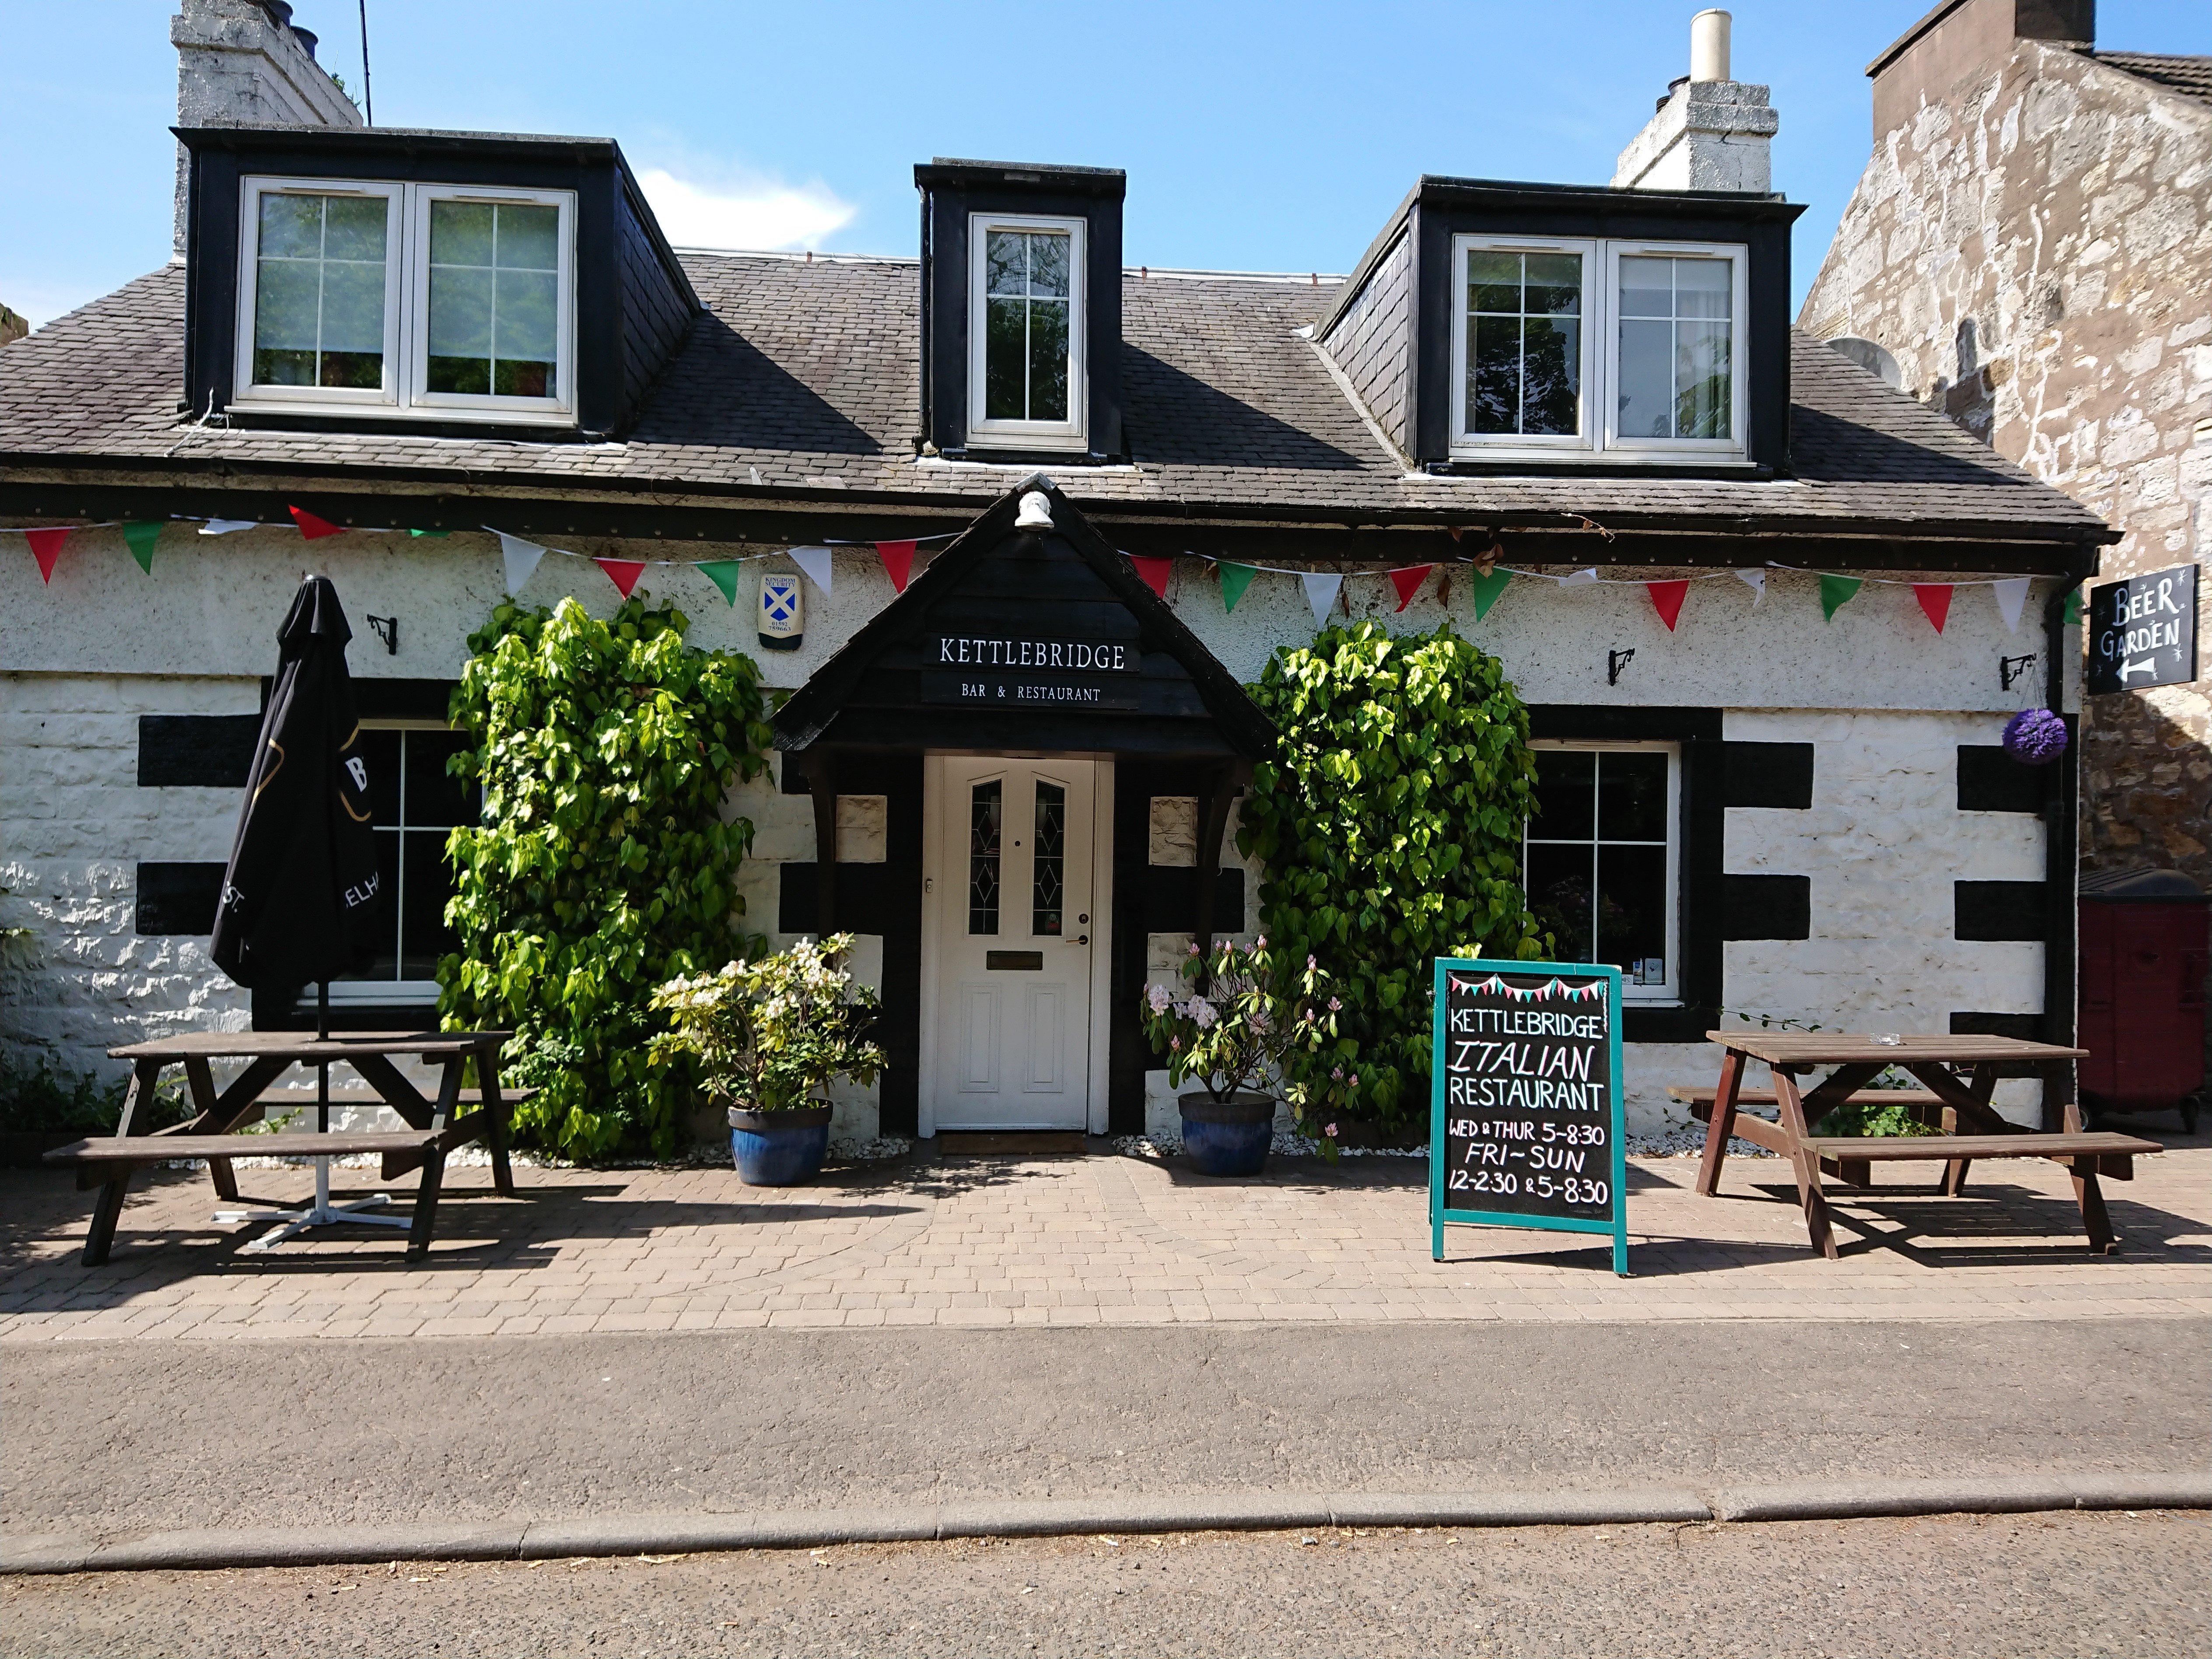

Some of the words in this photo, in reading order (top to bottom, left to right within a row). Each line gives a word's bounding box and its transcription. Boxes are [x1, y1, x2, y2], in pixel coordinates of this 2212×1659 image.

[2112, 577, 2180, 626] BEER
[940, 638, 1124, 669] KETTLEBRIDGE
[2100, 617, 2180, 662] GARDEN
[962, 683, 986, 697] BAR
[998, 686, 1006, 698] &
[1017, 686, 1100, 701] RESTAURANT
[1451, 1008, 1603, 1040] KETTLEBRIDGE
[1447, 1040, 1595, 1082] ITALIAN
[1450, 1077, 1604, 1111] RESTAURANT
[1449, 1118, 1478, 1137] WED
[1482, 1122, 1490, 1134] &
[1492, 1121, 1536, 1141] THUR
